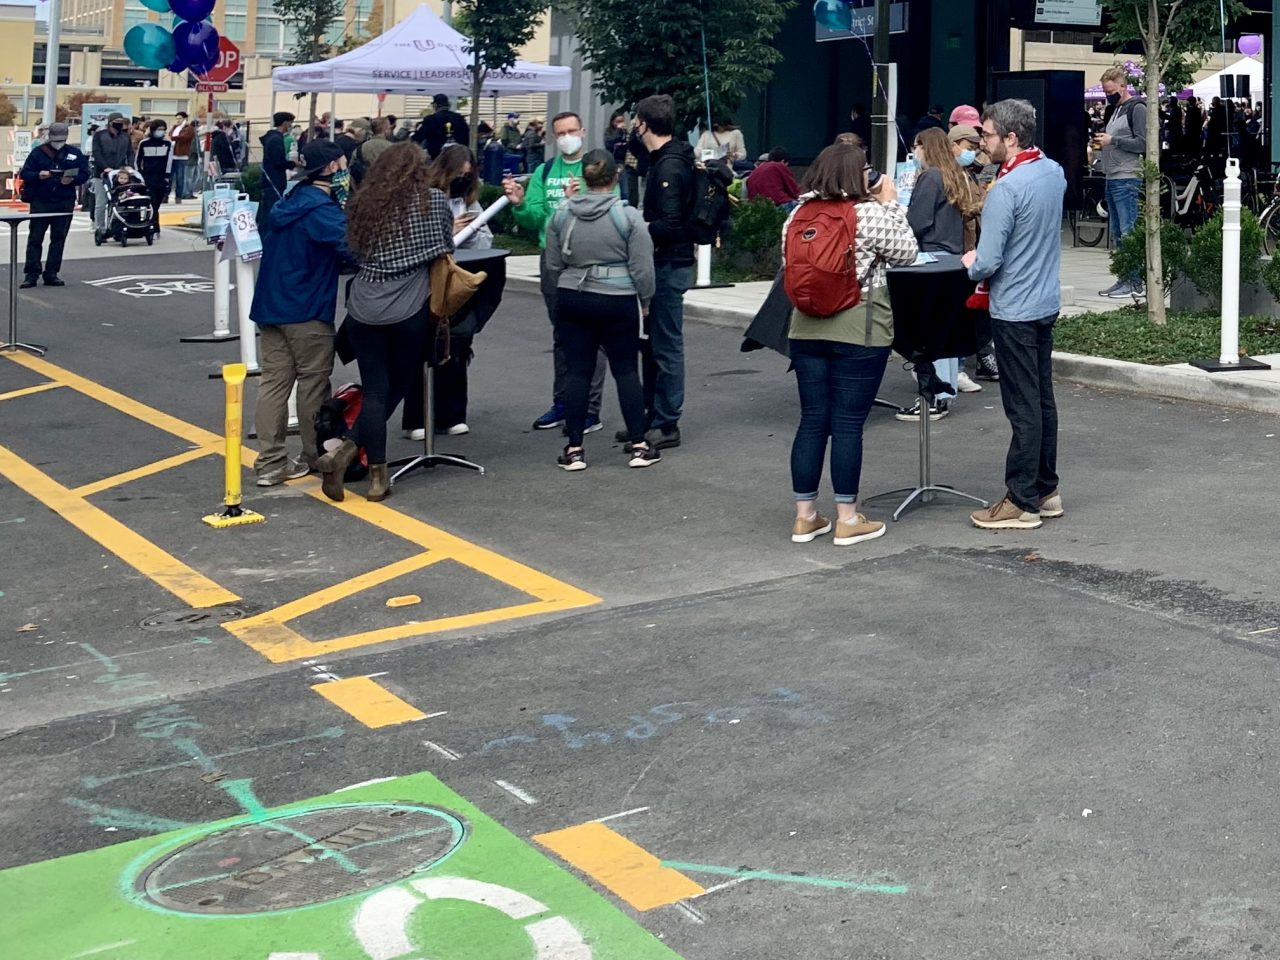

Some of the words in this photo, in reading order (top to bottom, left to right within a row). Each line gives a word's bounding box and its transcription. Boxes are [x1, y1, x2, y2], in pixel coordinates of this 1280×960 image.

[372, 70, 412, 79] SERVICE
[419, 70, 471, 79] LEADERSH
[485, 71, 538, 80] ADVOCACY
